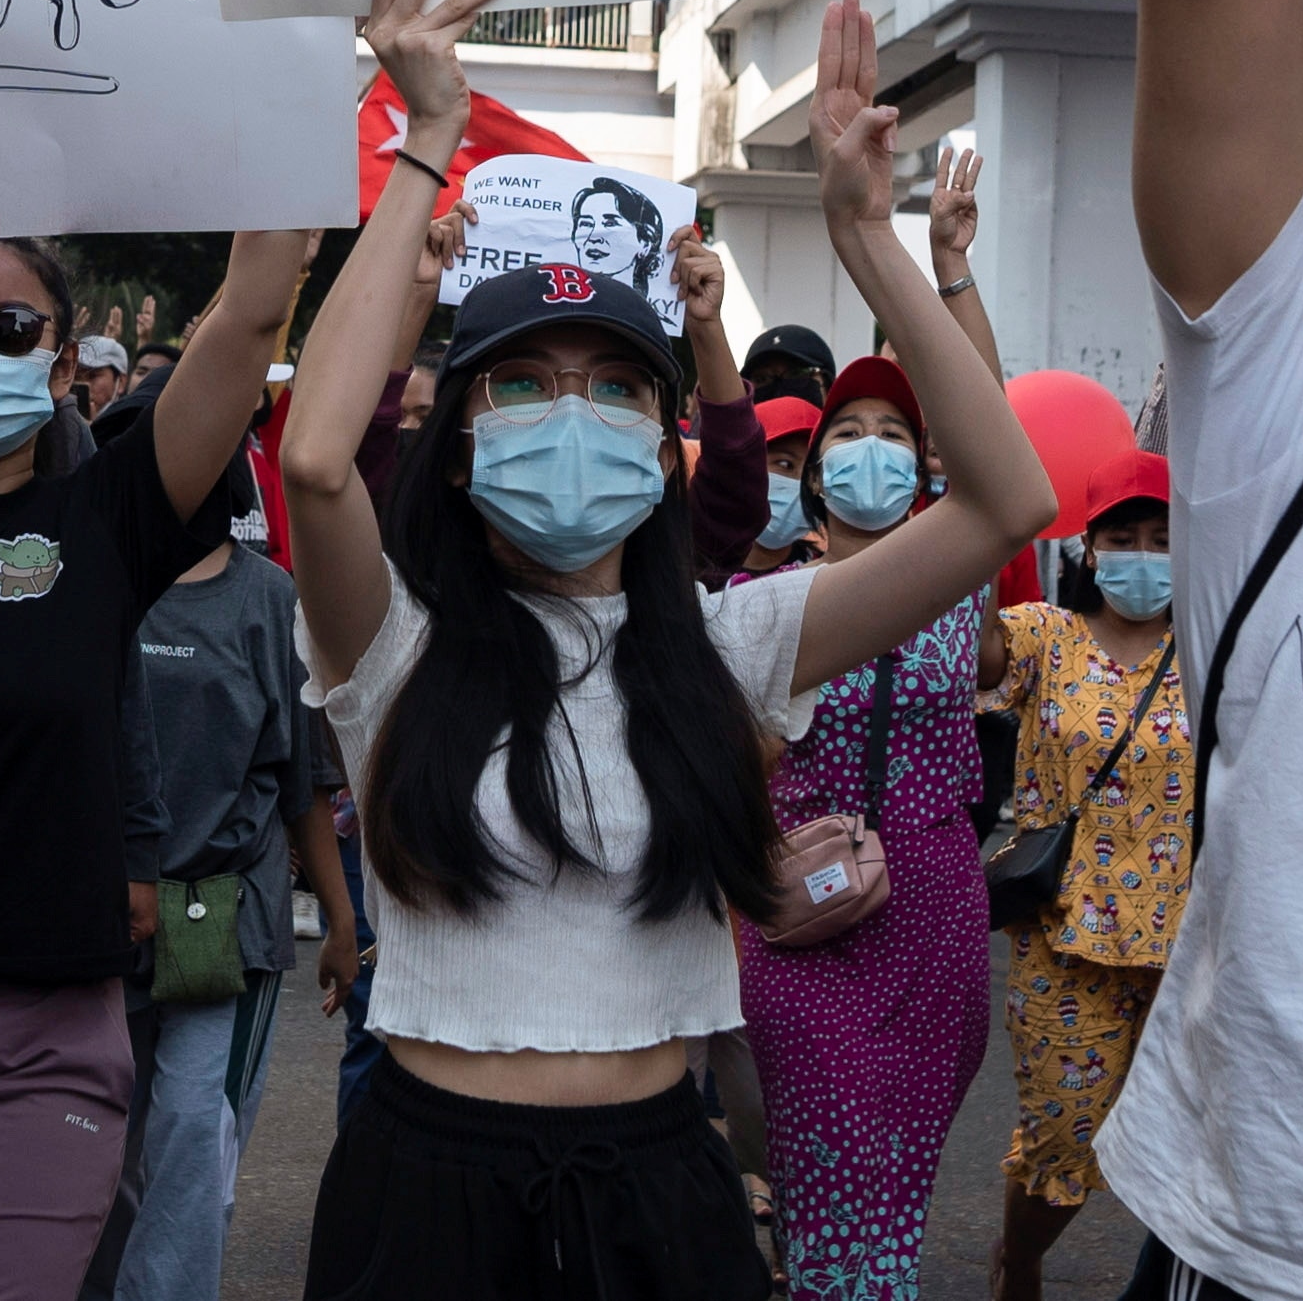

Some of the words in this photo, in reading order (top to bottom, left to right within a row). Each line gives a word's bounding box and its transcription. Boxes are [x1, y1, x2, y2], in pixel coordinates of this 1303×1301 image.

[473, 176, 494, 191] WE
[498, 176, 542, 190] WANT
[470, 195, 500, 206] OUR
[503, 196, 562, 213] LEADER
[538, 263, 596, 304] B
